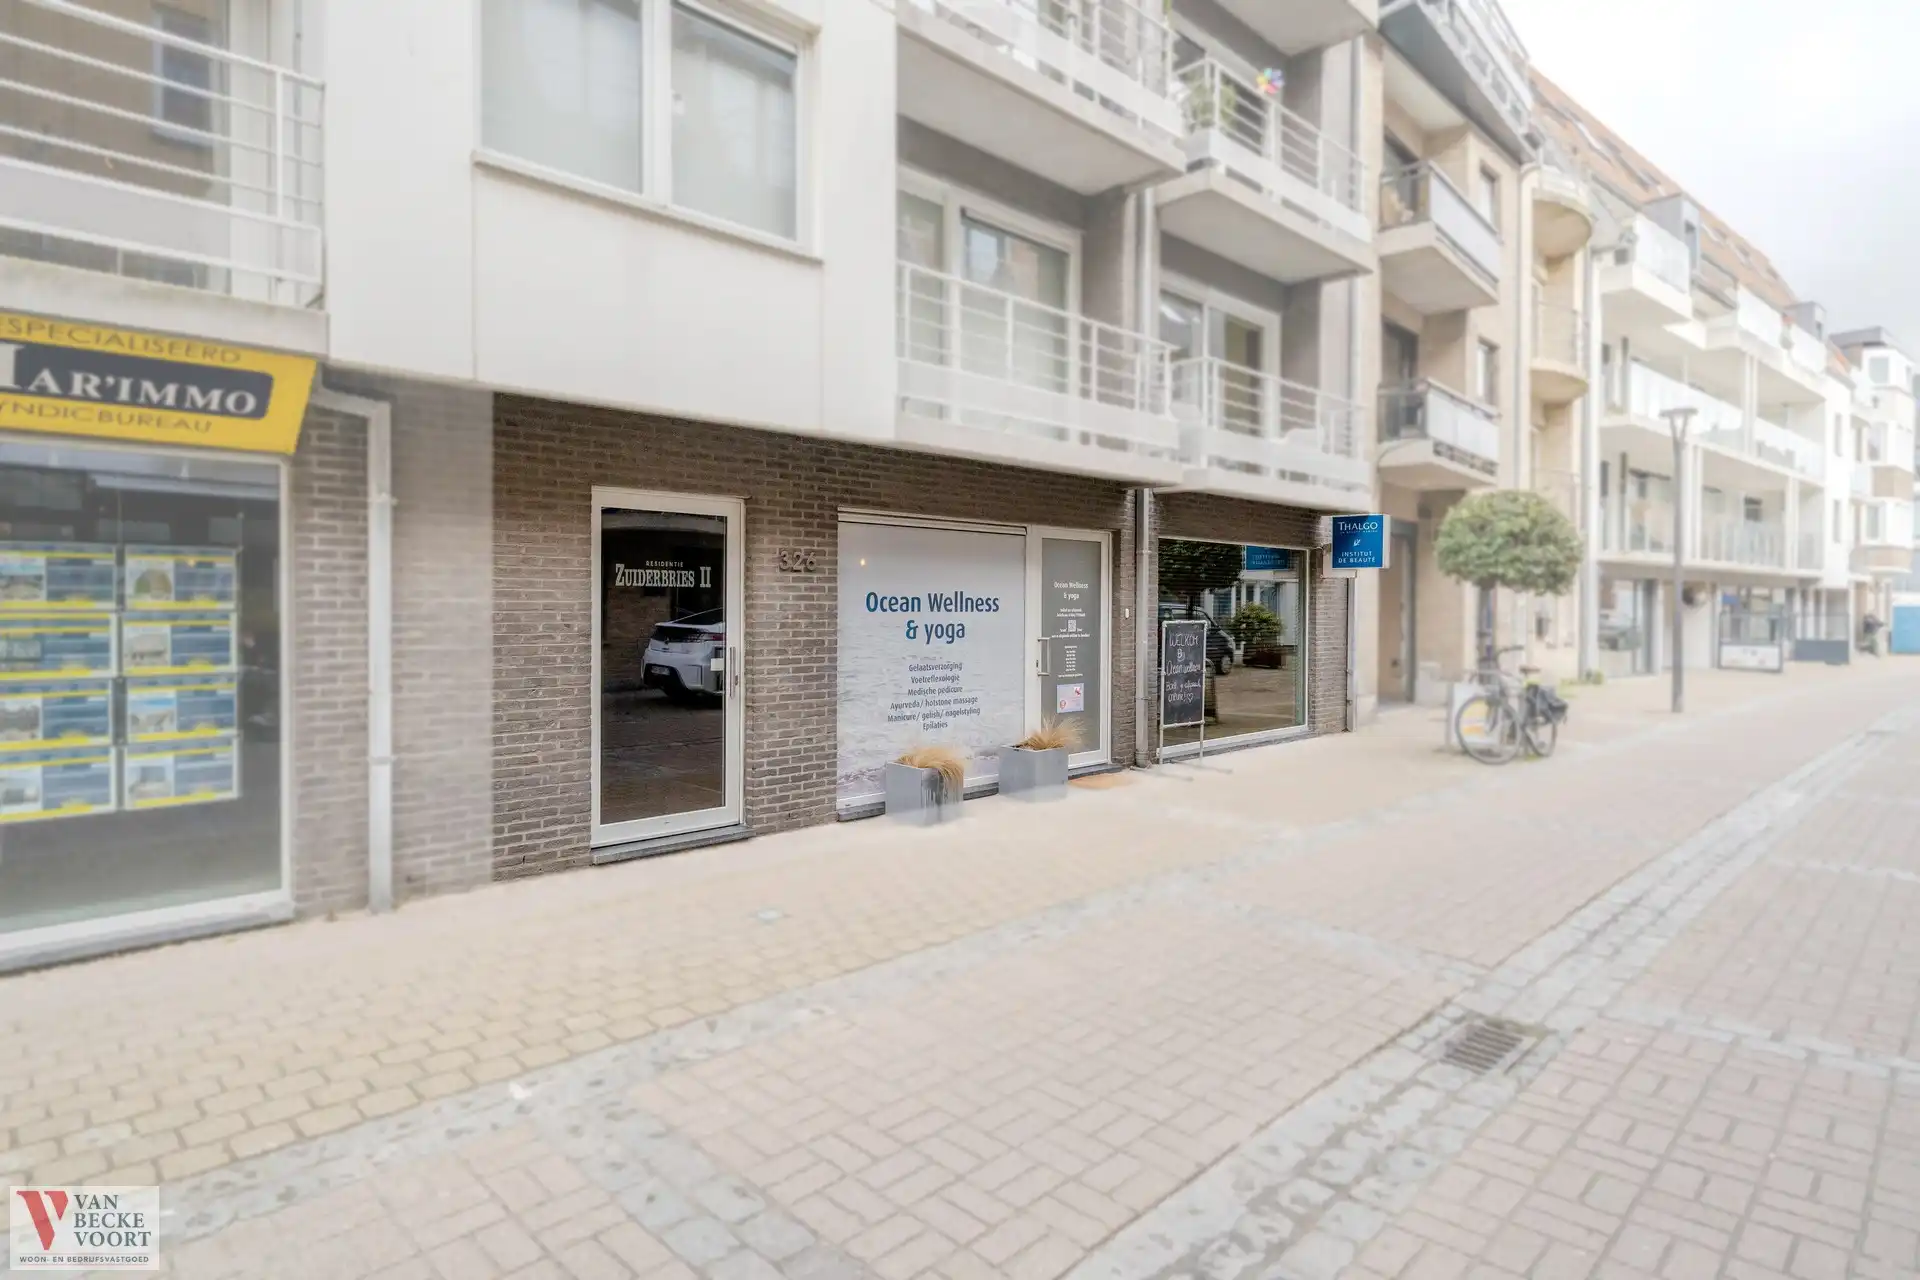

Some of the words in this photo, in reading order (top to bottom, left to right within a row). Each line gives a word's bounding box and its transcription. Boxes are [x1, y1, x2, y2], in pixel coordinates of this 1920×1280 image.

[0, 317, 241, 364] SPECIALISEERD
[1337, 521, 1378, 531] THALGO
[866, 591, 921, 612] Ocean
[928, 591, 1000, 612] Wellness
[905, 620, 918, 639] &
[924, 622, 966, 644] yoga
[908, 662, 963, 672] Gelaatsverzorging
[910, 674, 961, 684] Voetreflexologie
[908, 688, 937, 696] Medische
[938, 686, 963, 696] pedicure
[922, 720, 948, 731] Epilaties
